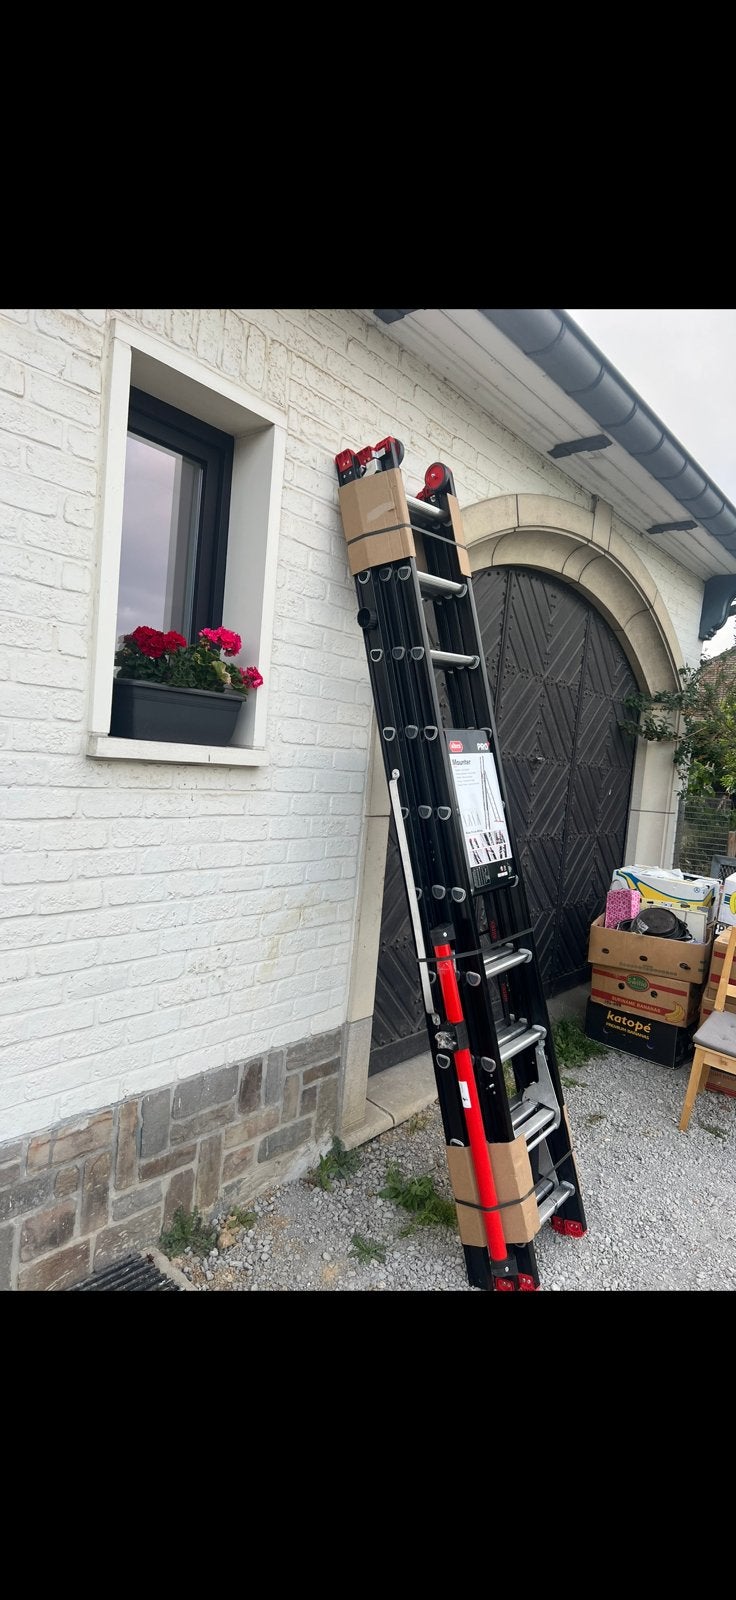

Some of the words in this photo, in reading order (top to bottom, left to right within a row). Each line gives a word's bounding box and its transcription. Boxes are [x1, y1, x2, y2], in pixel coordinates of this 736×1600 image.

[477, 743, 488, 751] PRO
[611, 995, 636, 1007] SURINAME
[636, 1002, 661, 1014] BANANAS
[606, 1010, 652, 1033] katopé
